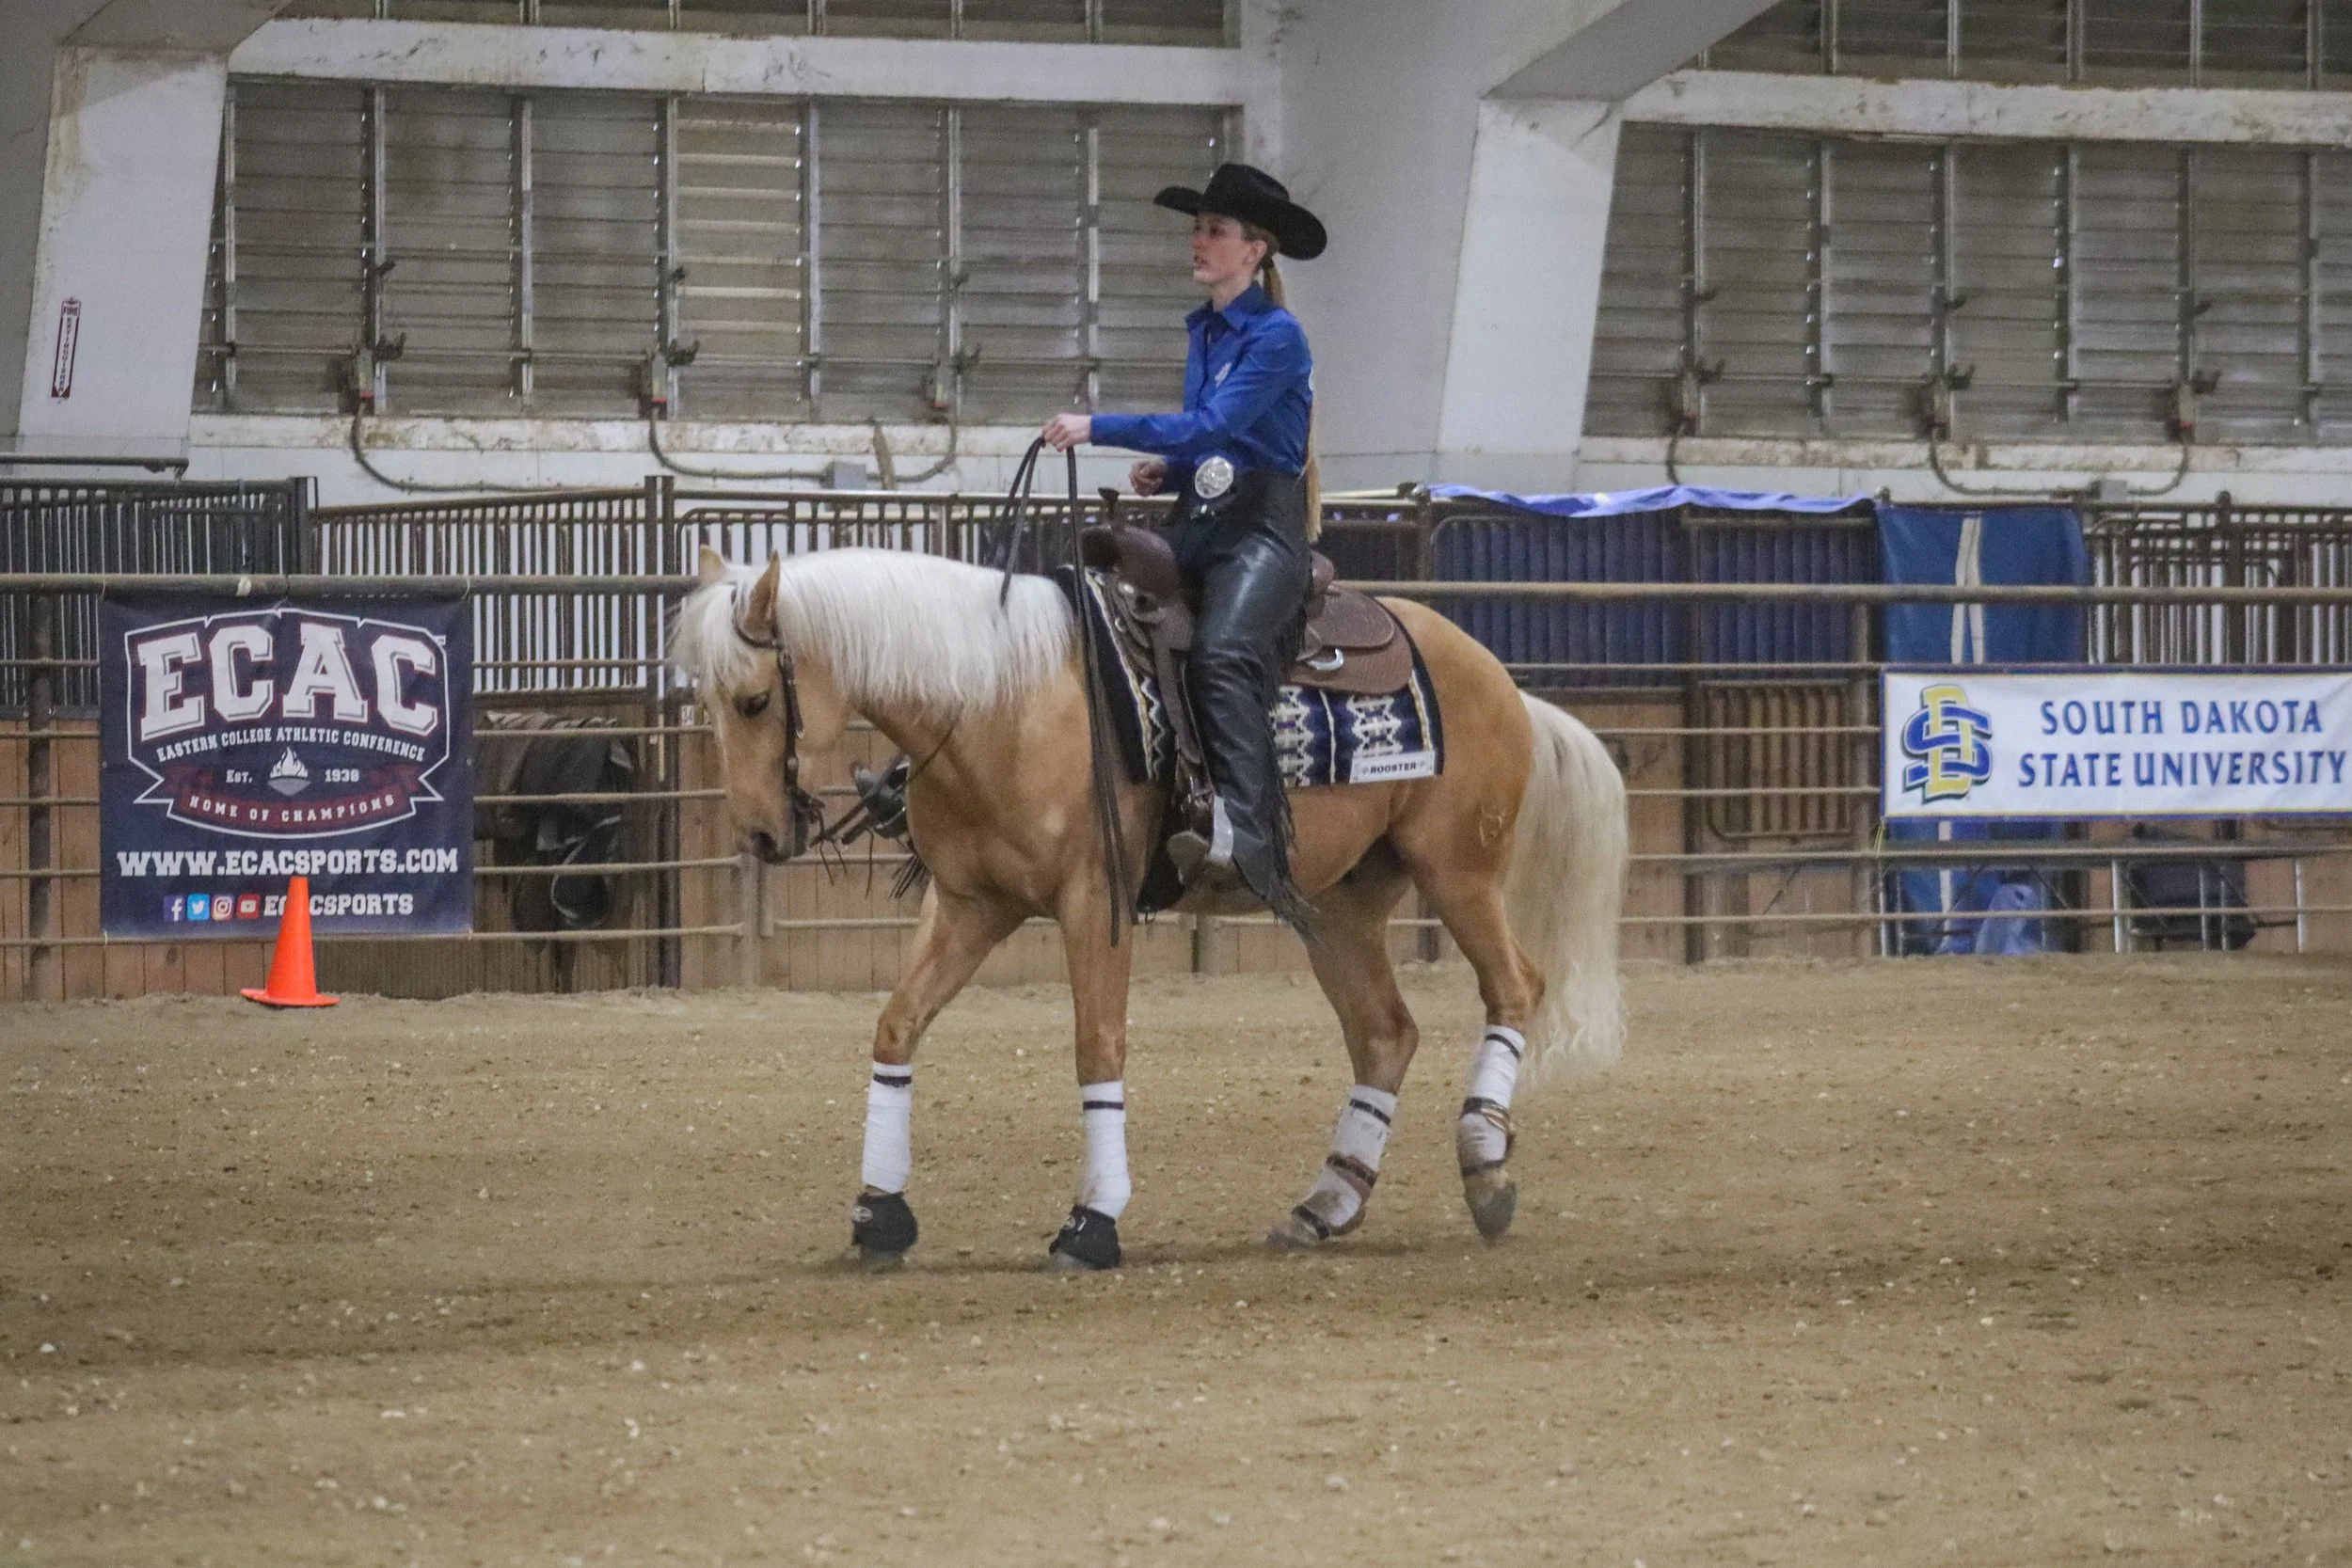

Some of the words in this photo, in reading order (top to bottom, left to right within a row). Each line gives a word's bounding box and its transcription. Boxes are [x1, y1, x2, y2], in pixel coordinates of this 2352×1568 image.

[63, 306, 78, 316] FIRE
[136, 623, 437, 741] ECAC
[2041, 700, 2164, 735] SOUTH
[2181, 699, 2323, 735] DAKOTA
[156, 734, 218, 763] EASTERN
[221, 727, 272, 747] COLLEGE
[276, 726, 340, 744] ATHLETIC
[342, 730, 426, 763] CONFERENCE
[1370, 762, 1417, 773] ROOSTER
[2018, 753, 2122, 786] STATE
[2135, 750, 2347, 786] UNIVERSITY
[189, 795, 238, 818] HOME
[249, 808, 269, 822] OF
[281, 794, 395, 823] CHAMPIONS
[117, 848, 458, 878] WWW.ECACSPORTS.COM
